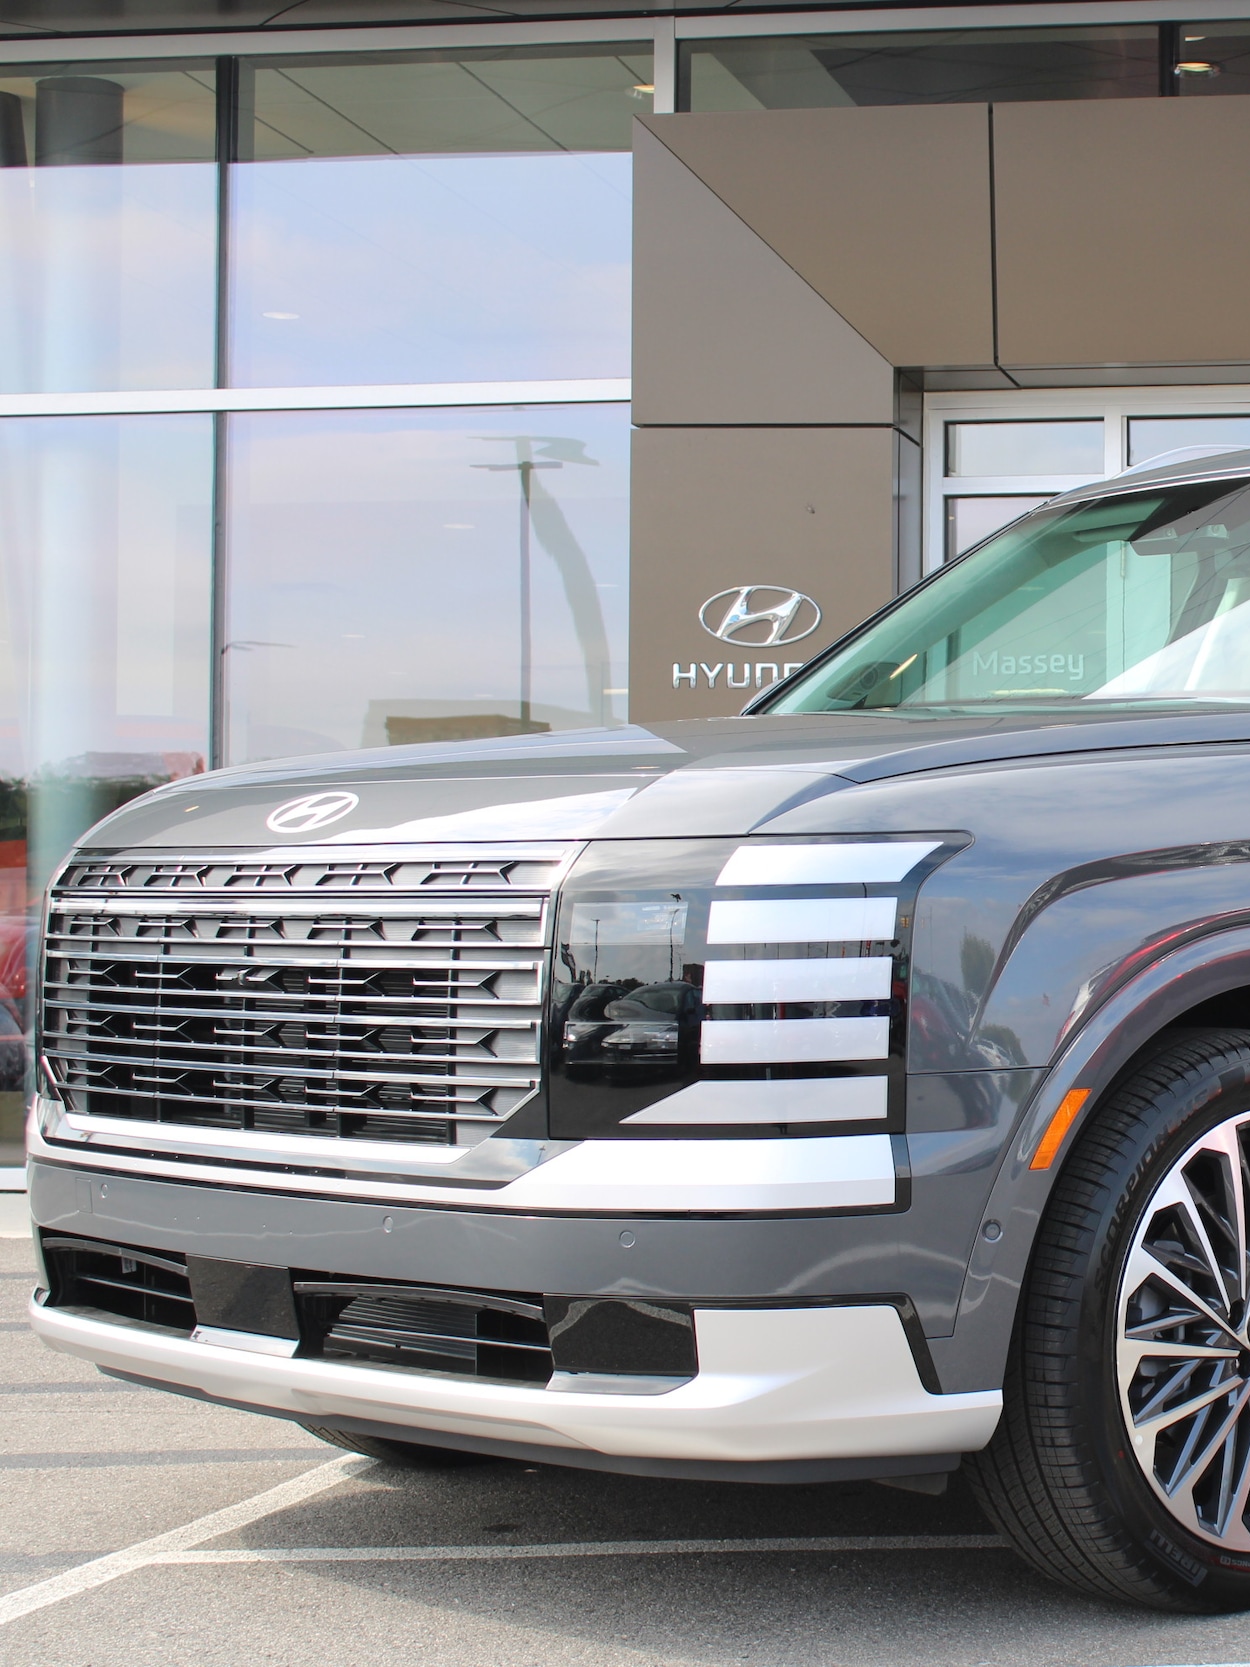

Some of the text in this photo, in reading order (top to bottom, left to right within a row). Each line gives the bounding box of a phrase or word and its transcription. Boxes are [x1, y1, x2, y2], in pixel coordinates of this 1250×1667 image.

[971, 650, 1085, 681] Massey
[1094, 1124, 1170, 1290] SCORPION
[1144, 1528, 1209, 1588] PIRELLI
